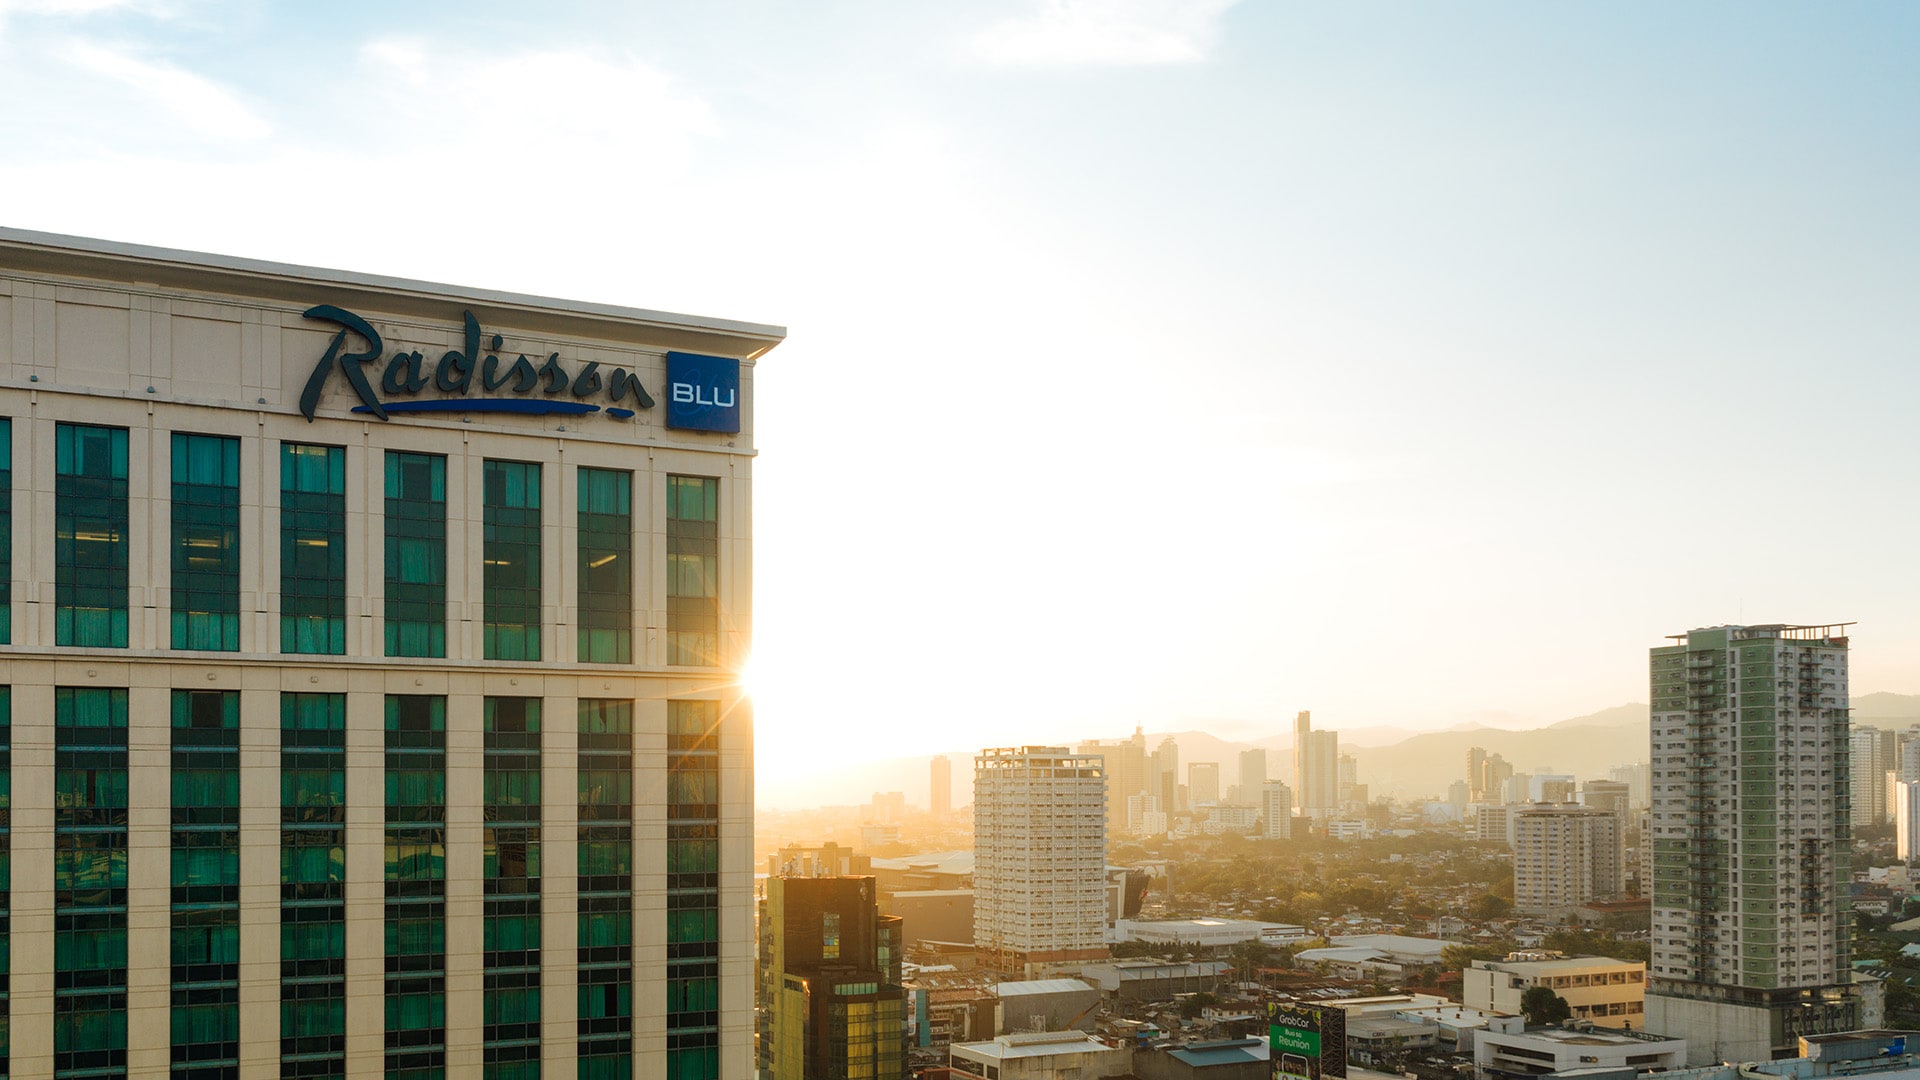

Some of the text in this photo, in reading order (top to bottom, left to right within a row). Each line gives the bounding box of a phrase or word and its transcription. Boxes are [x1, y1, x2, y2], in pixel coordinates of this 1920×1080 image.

[300, 304, 735, 423] Radisson BLU
[1279, 1014, 1310, 1028] GrabCar
[1278, 1035, 1310, 1050] Reunion
